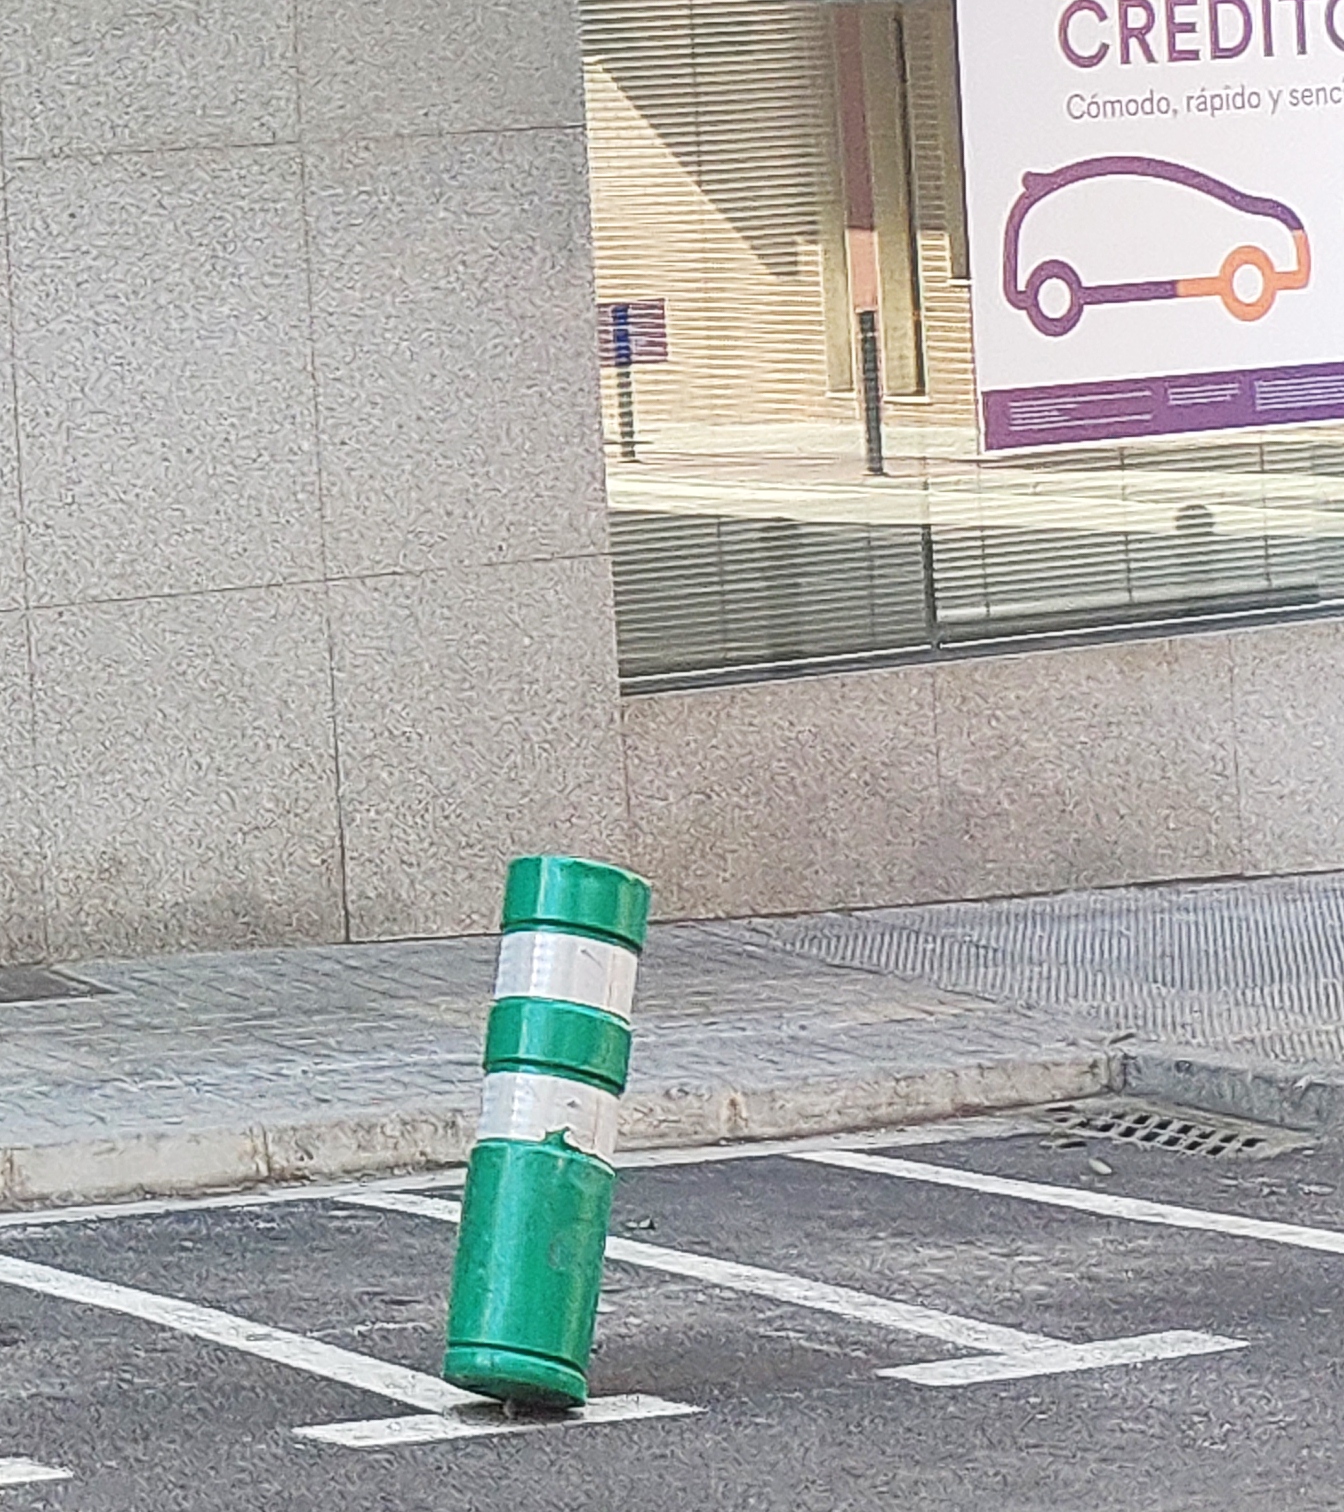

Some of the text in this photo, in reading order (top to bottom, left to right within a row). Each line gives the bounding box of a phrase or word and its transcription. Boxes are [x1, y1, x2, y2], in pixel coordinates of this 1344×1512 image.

[1066, 77, 1344, 119] Cómodo, rápido y senc
